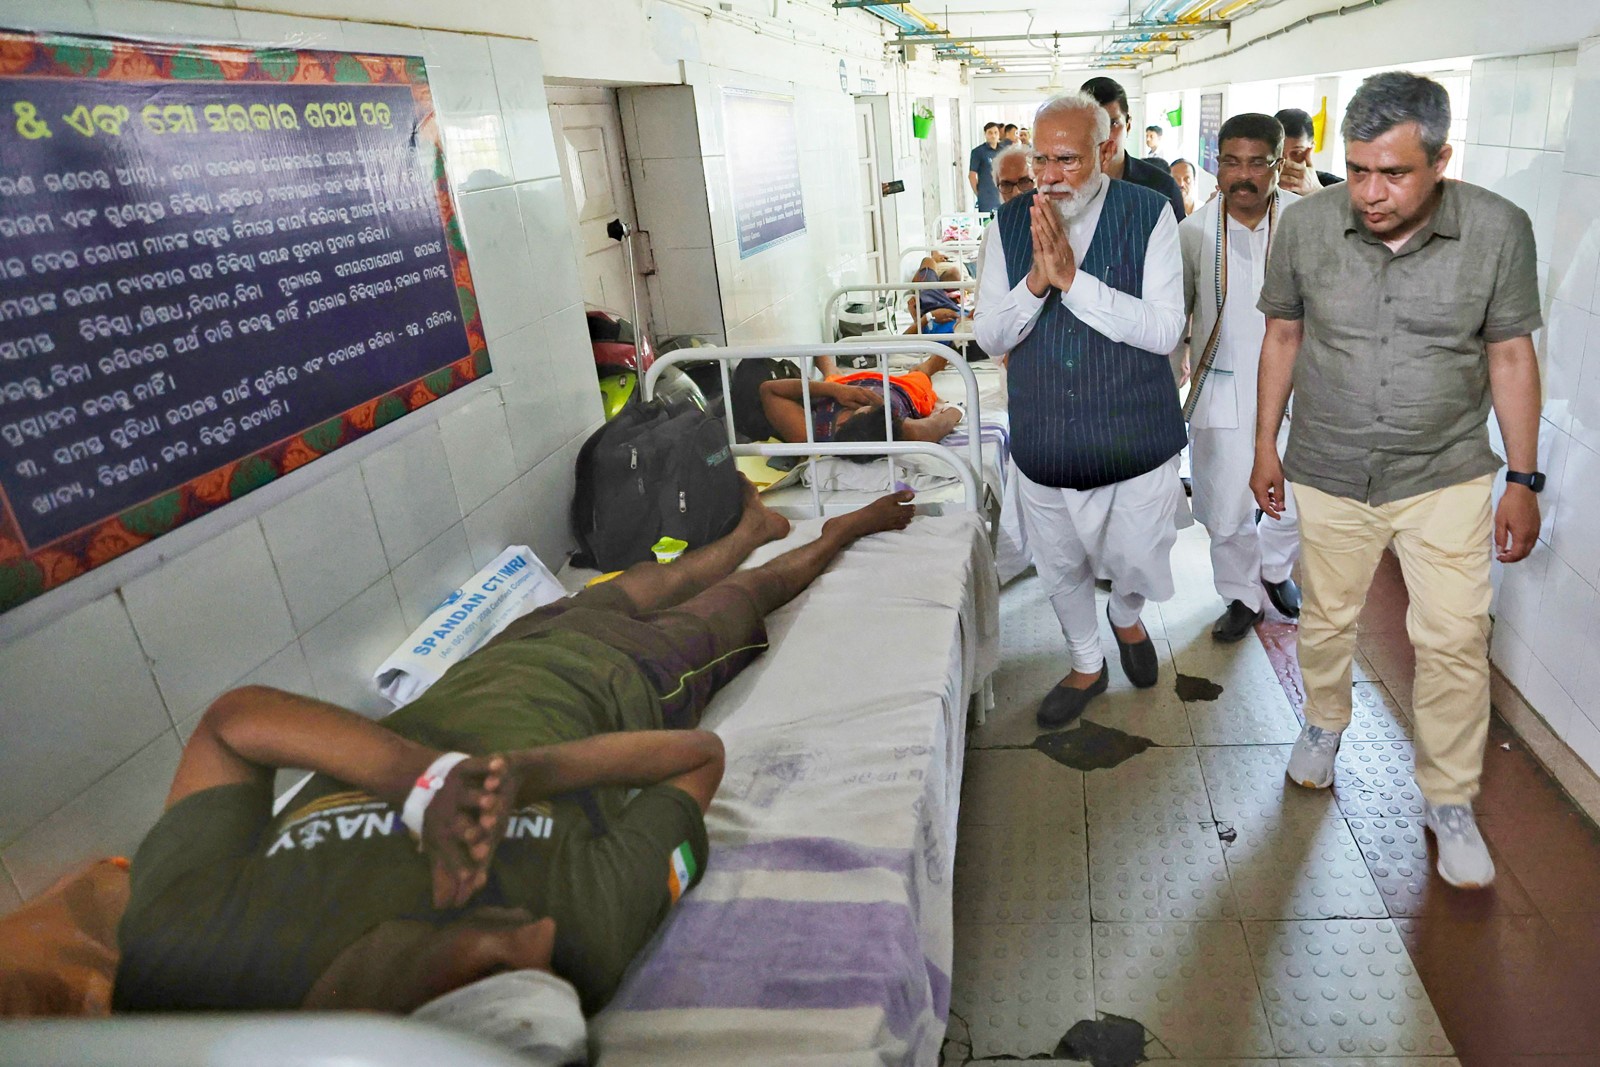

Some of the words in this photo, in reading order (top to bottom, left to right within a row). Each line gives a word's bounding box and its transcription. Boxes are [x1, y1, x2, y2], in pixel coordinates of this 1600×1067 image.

[62, 105, 130, 137] ଏବଂ
[142, 105, 197, 134] ମୋ
[204, 104, 300, 131] ସରକାର
[305, 103, 356, 127] ଶପଥ
[360, 103, 393, 129] ପତ୍ର
[61, 209, 97, 228] ଏବଂ
[84, 241, 139, 264] ରୋଗୀ
[0, 293, 57, 321] ମସ୍ତଙ୍କ
[117, 269, 186, 294] ବ୍ୟବହାର
[189, 263, 213, 279] ସହ
[292, 241, 324, 263] ସୂଚନା
[326, 234, 355, 254] ପ୍ରଦାନ
[302, 357, 323, 373] ଏବଂ
[413, 593, 487, 656] SPANDAN
